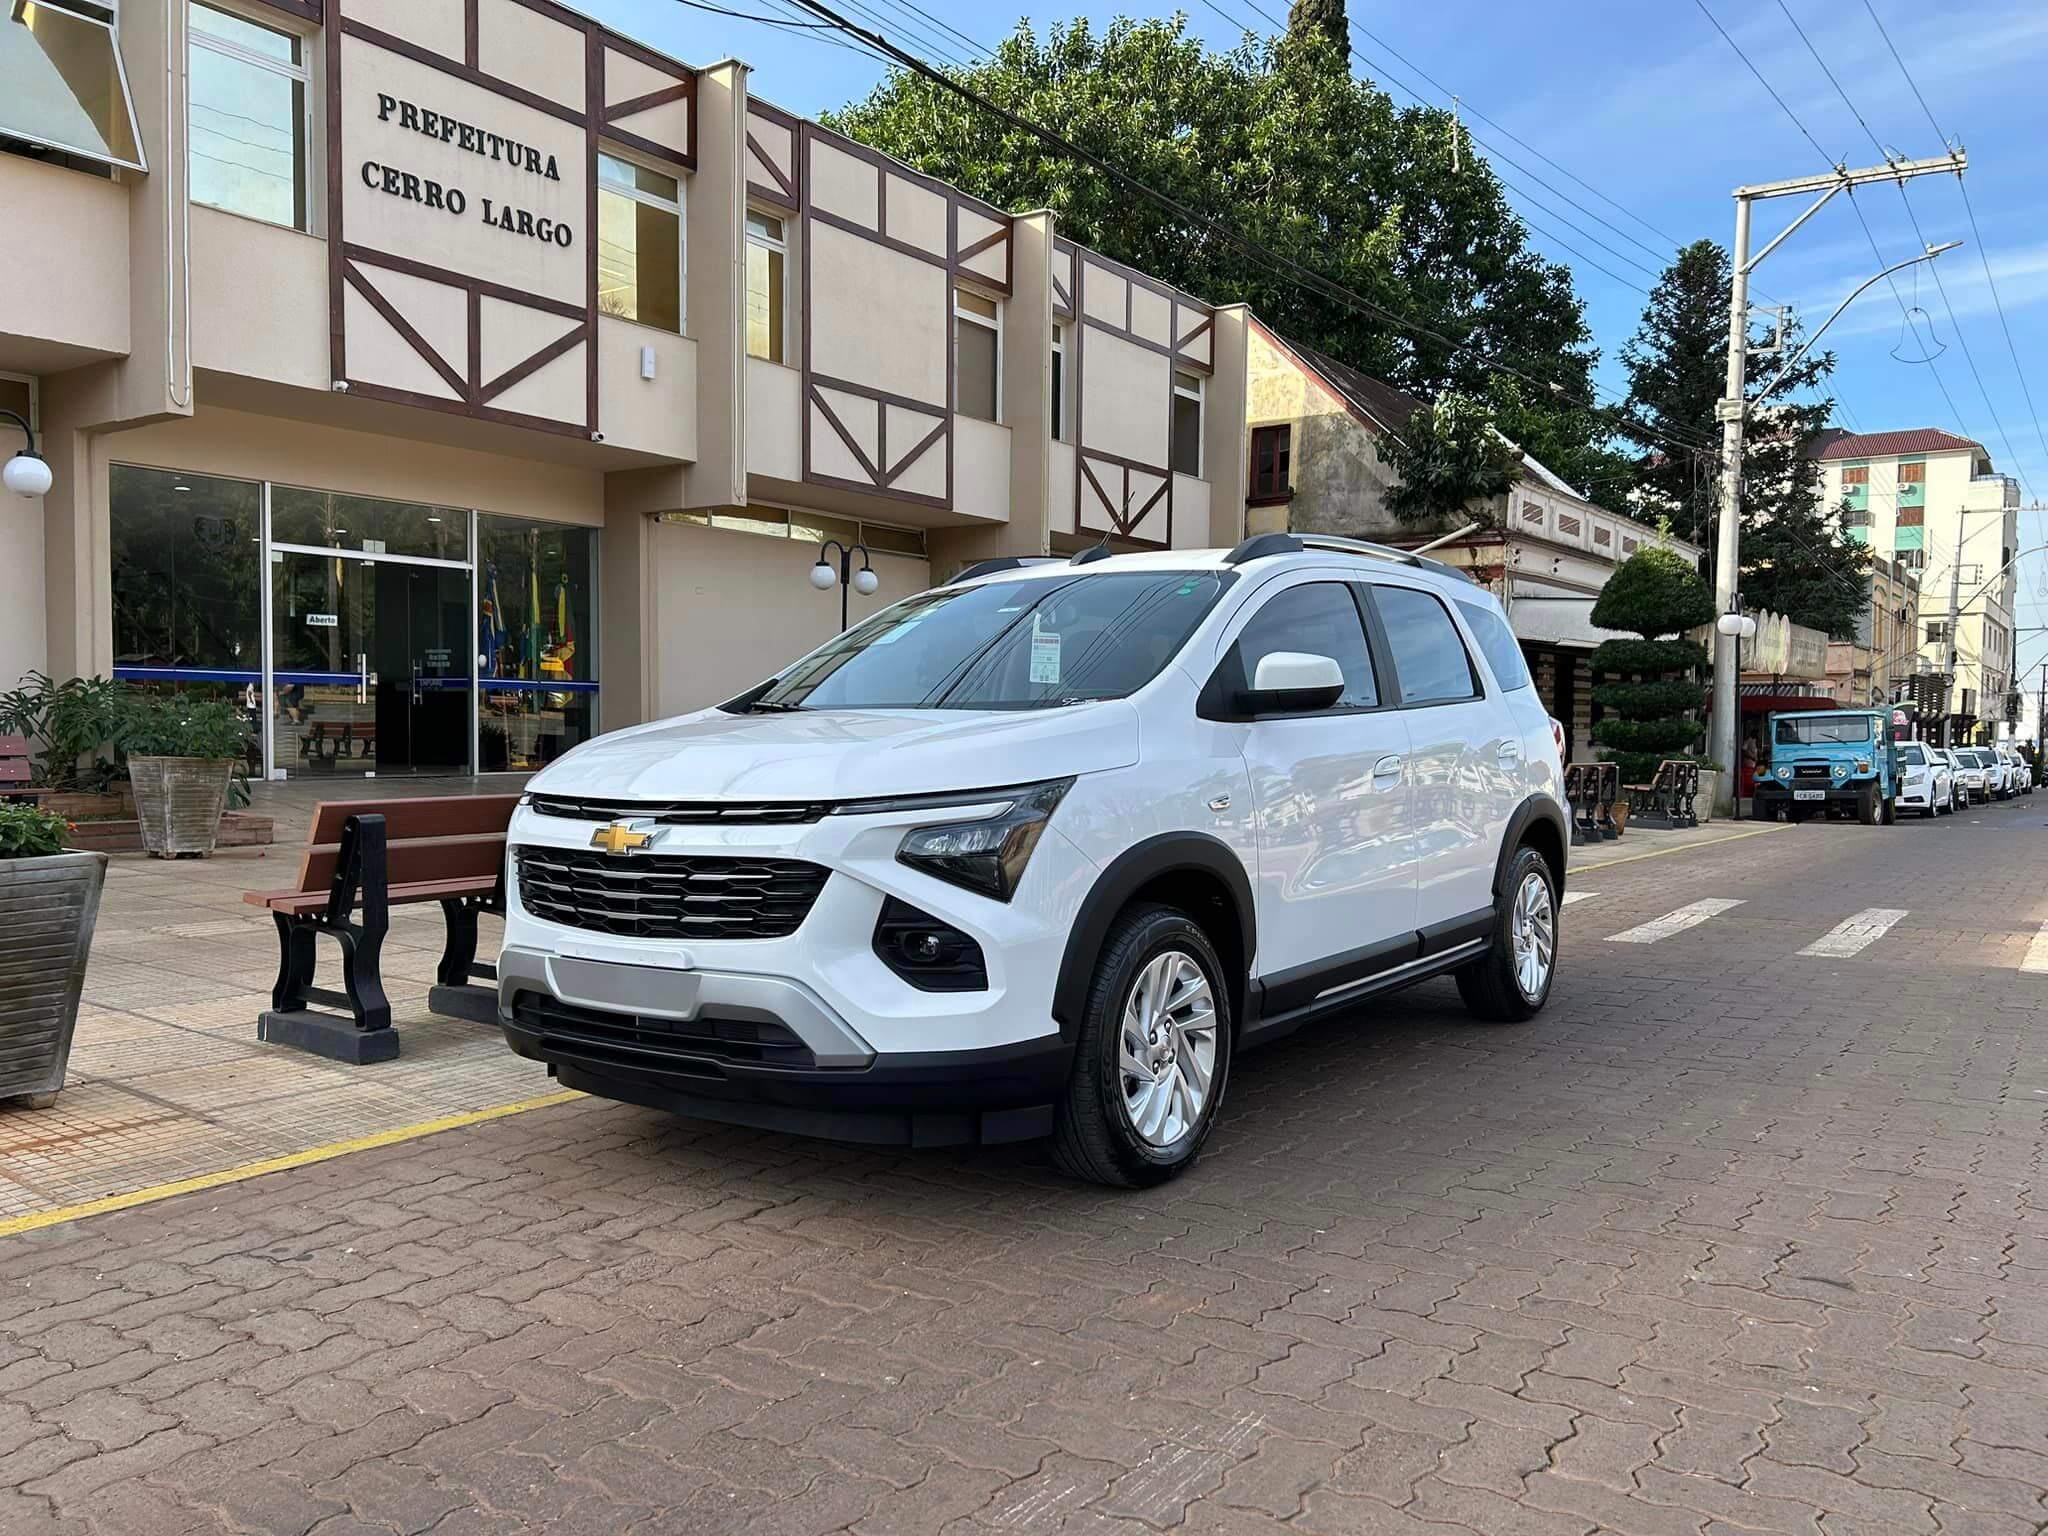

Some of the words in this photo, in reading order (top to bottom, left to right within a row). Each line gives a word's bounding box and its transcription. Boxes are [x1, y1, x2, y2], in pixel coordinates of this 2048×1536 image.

[377, 93, 560, 181] PREFEITURA
[361, 161, 466, 215] CERRO
[482, 198, 572, 247] LARGO
[309, 615, 336, 624] Aberto
